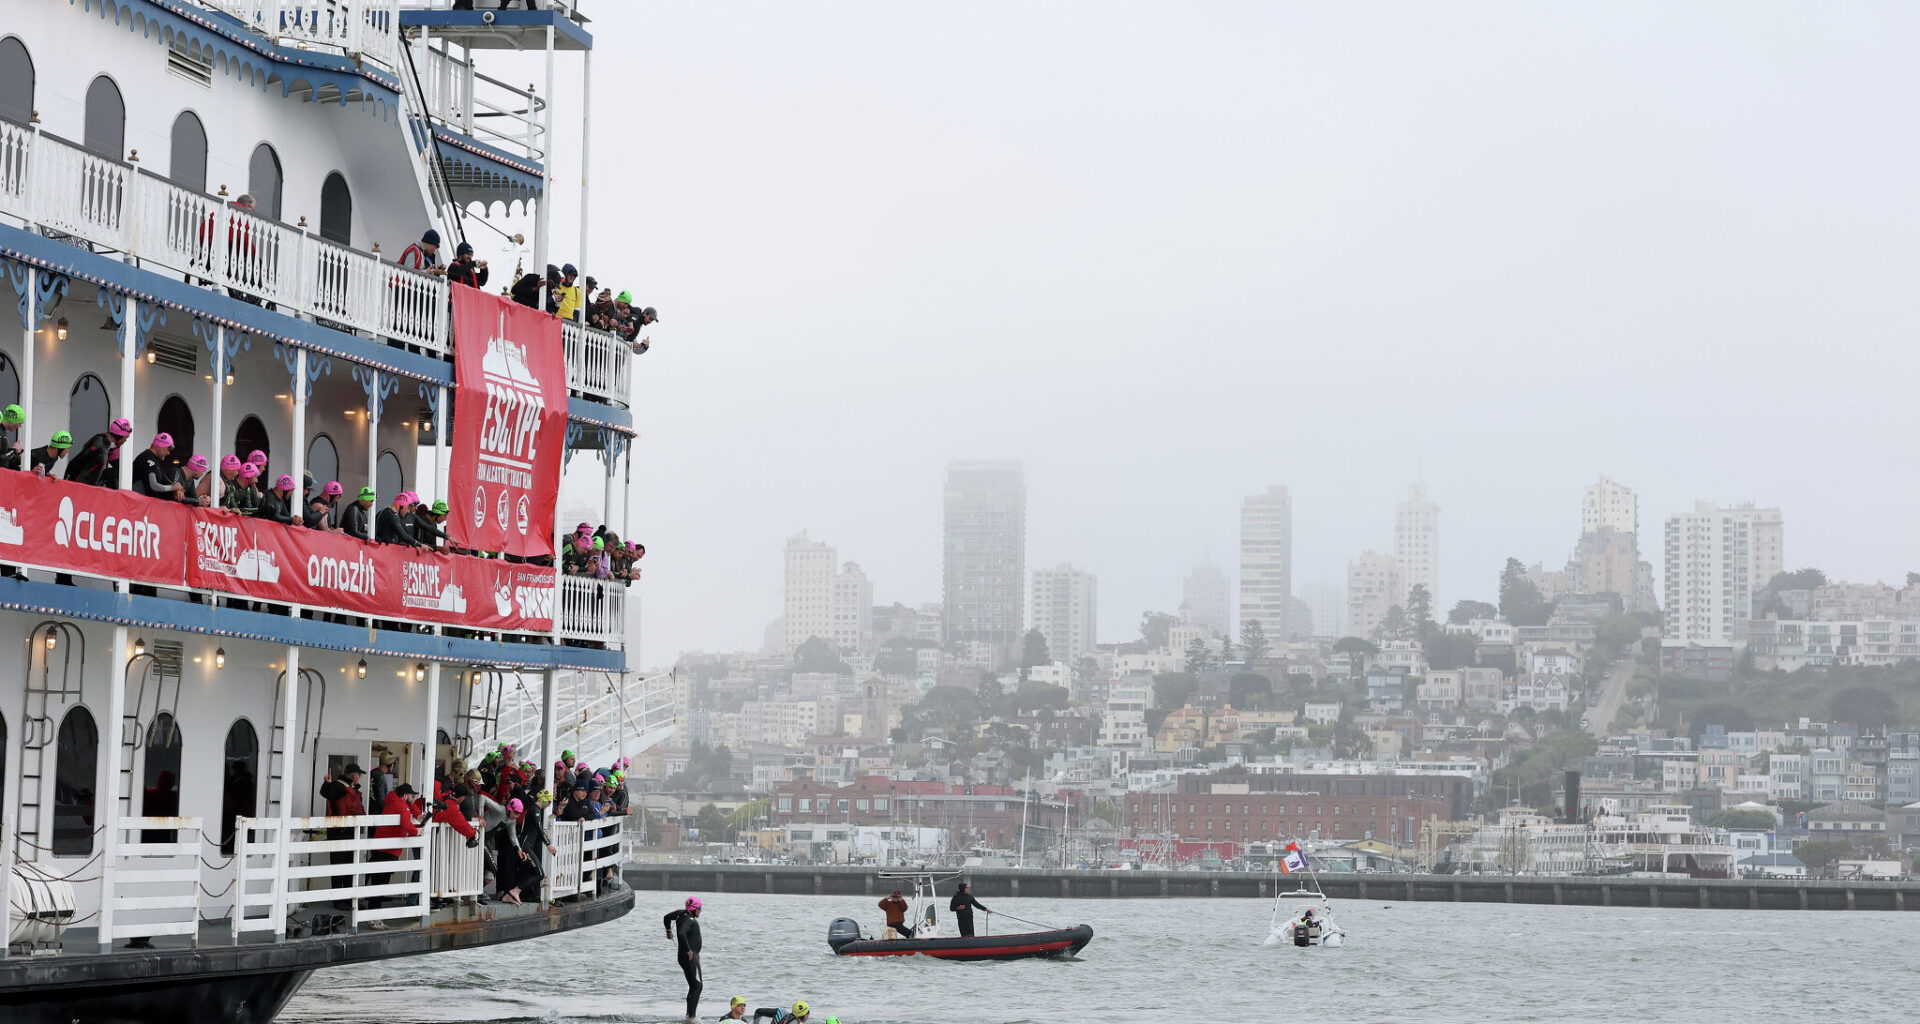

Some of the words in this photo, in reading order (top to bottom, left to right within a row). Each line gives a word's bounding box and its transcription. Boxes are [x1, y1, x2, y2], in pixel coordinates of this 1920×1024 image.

[480, 382, 545, 460] ESCAPE
[307, 550, 376, 596] amazfit
[408, 561, 440, 597] ESCAPE
